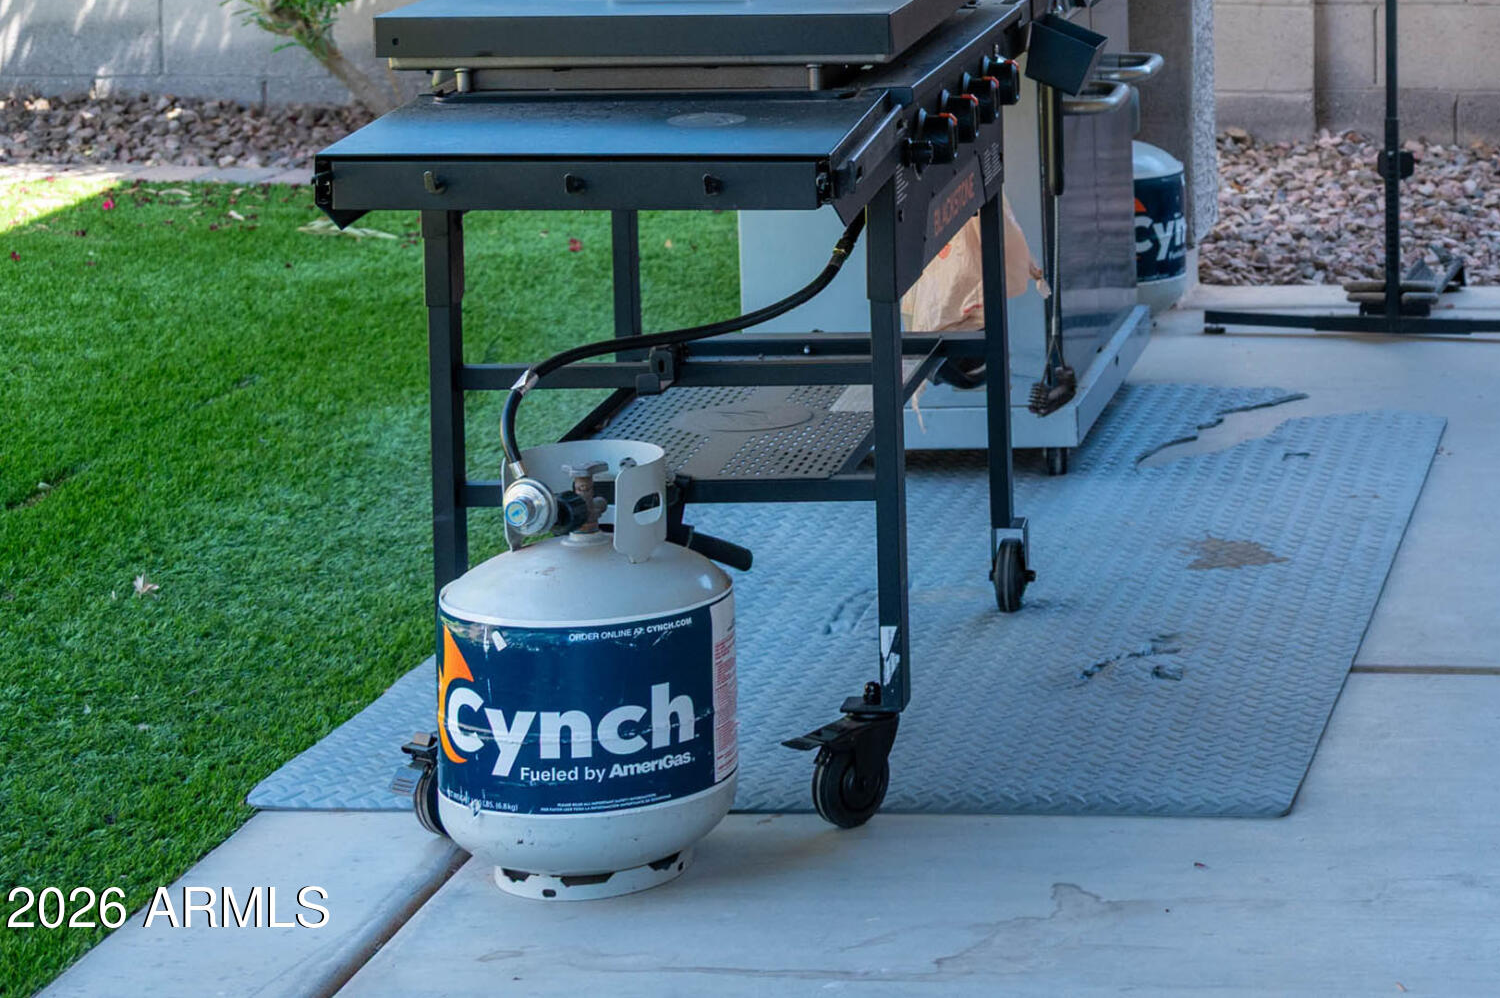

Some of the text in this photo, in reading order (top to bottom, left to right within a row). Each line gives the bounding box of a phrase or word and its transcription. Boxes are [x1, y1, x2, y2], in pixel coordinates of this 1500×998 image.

[568, 632, 600, 643] ORDER
[600, 628, 632, 639] ONLINE
[646, 616, 693, 634] CYNCH.COM
[447, 681, 696, 778] Cynch
[520, 765, 579, 782] Fueled
[584, 766, 606, 783] by
